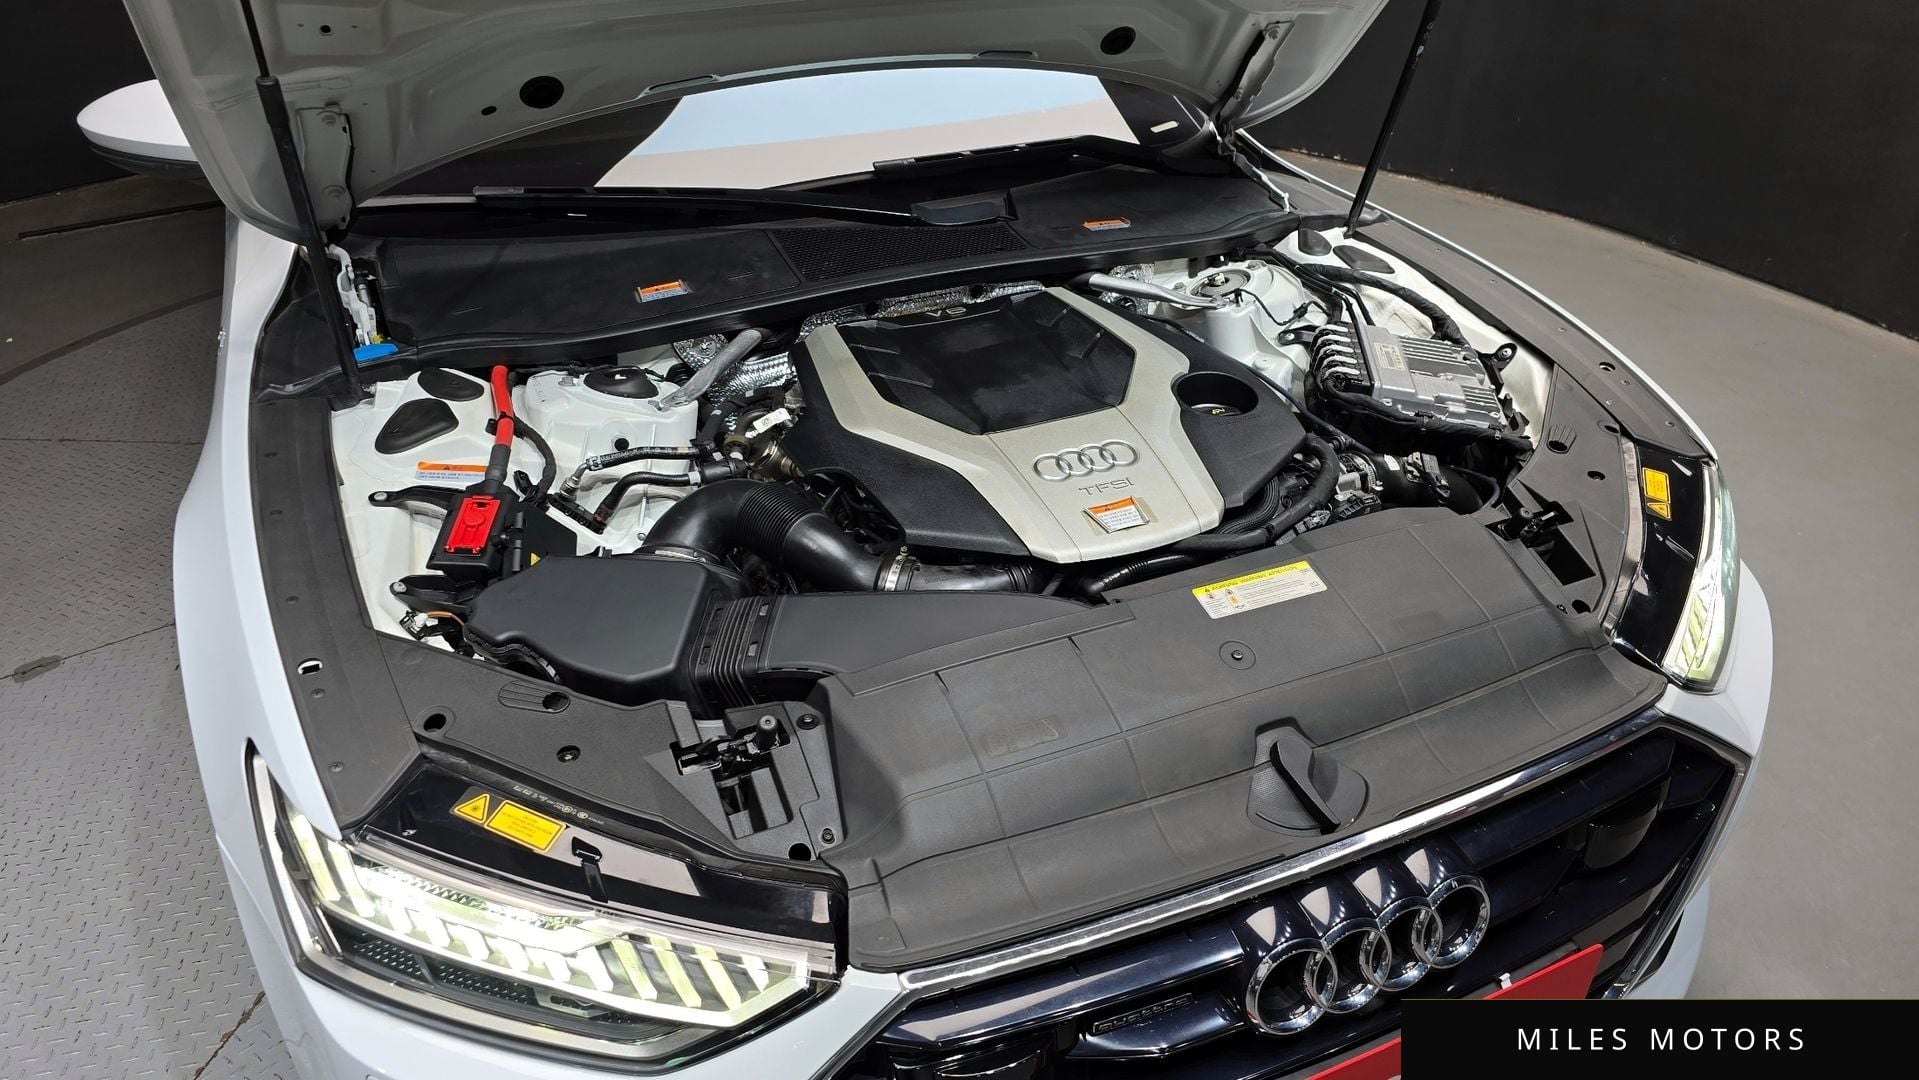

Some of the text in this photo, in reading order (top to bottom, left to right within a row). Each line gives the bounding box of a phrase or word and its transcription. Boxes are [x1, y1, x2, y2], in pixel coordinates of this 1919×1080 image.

[925, 306, 967, 317] V6
[1078, 477, 1135, 496] TFSI
[1098, 997, 1191, 1031] quattro
